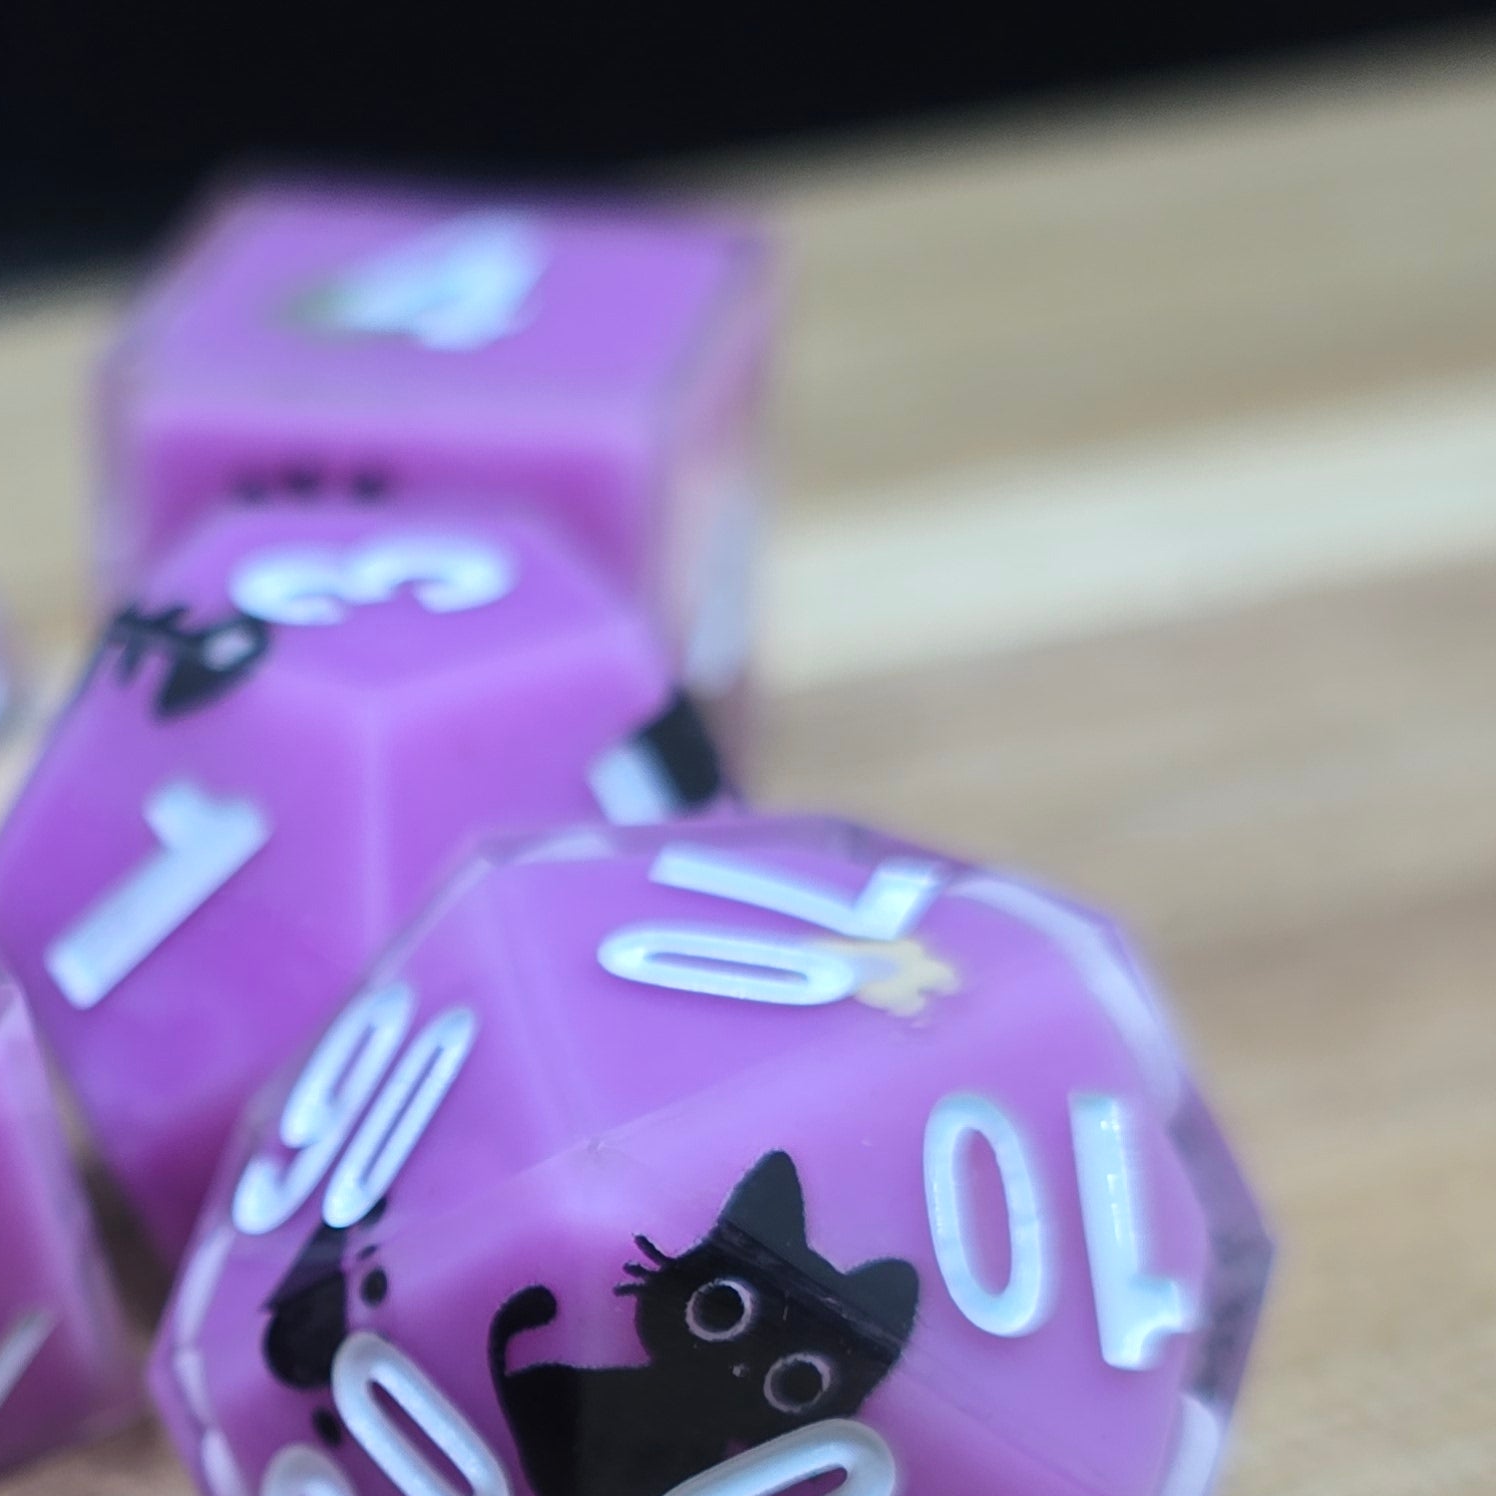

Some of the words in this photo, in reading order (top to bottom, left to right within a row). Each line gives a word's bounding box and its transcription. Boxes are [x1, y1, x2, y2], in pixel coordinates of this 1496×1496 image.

[230, 535, 513, 625] 3
[46, 784, 270, 1009] 1
[597, 844, 943, 1006] 70
[922, 1092, 1192, 1369] 10
